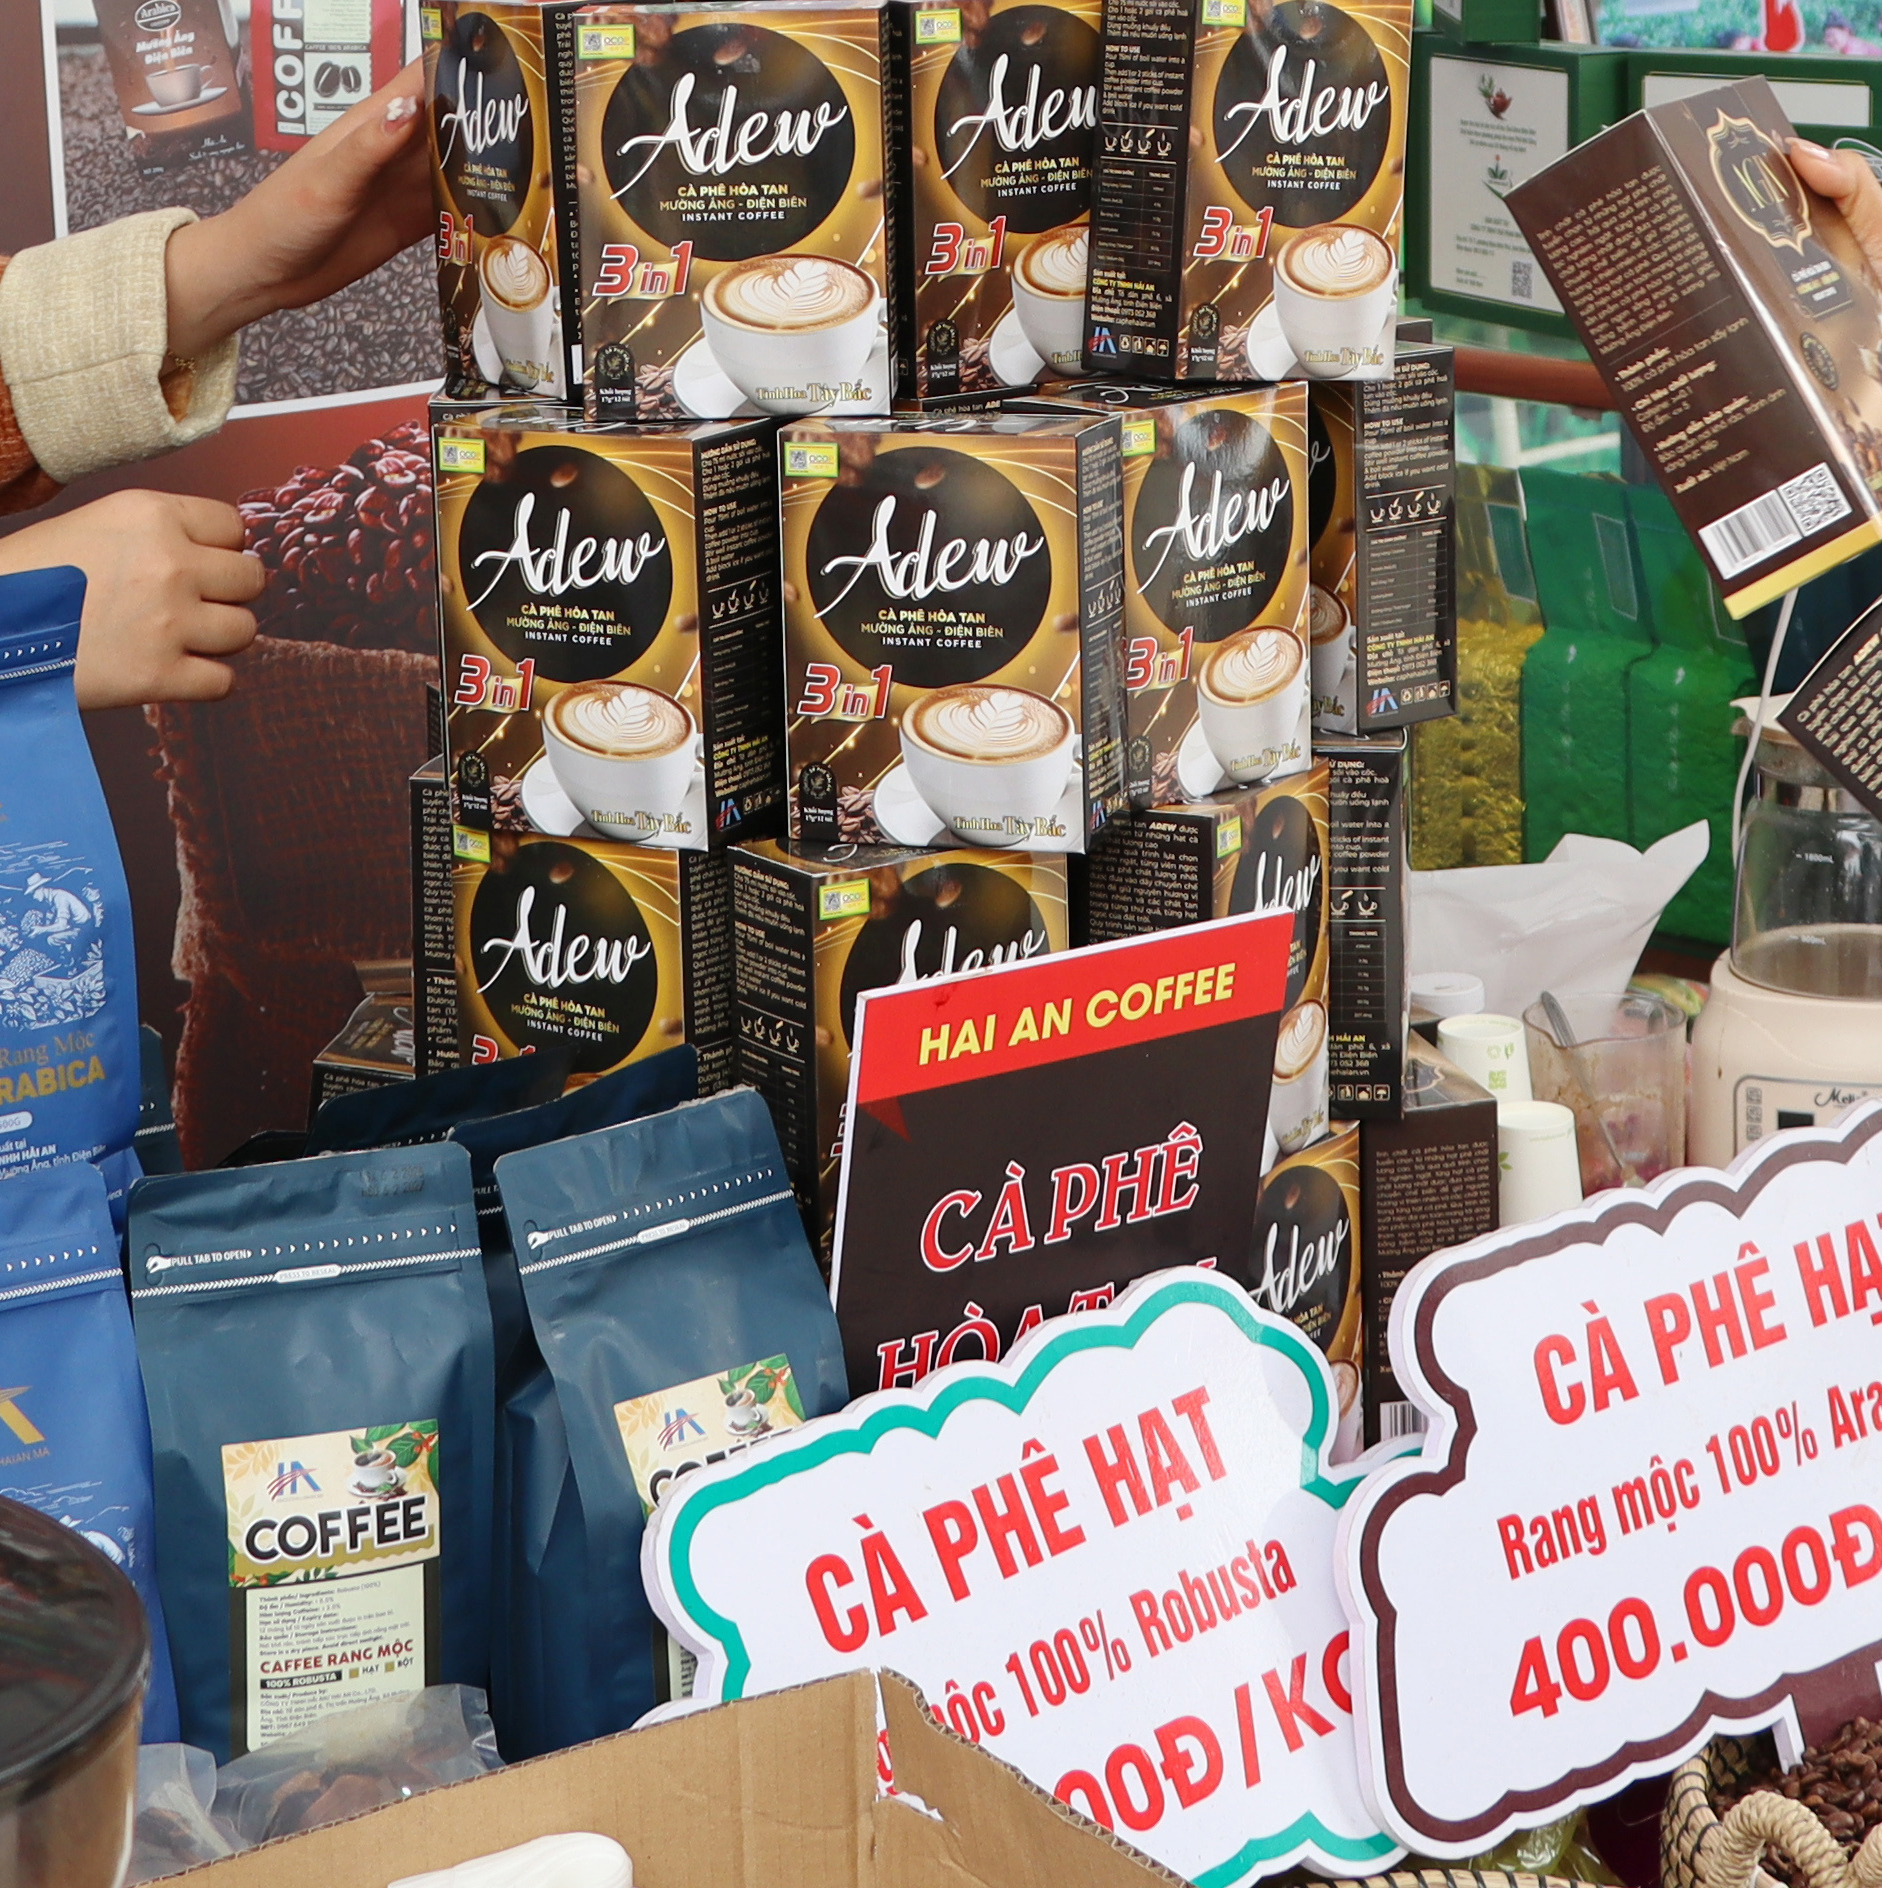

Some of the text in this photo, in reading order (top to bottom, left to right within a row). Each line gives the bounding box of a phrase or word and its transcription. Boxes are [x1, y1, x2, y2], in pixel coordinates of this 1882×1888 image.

[439, 57, 528, 170] Adew
[610, 72, 848, 200] Adew
[1215, 45, 1388, 163] Adew
[678, 184, 697, 197] CÀ
[700, 183, 726, 196] PHÊ
[761, 184, 788, 195] TAN
[682, 211, 785, 221] INSTANT COFFEE
[747, 198, 776, 210] ĐIỆN
[779, 198, 807, 208] BIÊN
[1267, 180, 1341, 190] INSTANT COFFEE
[466, 492, 667, 611] Adew
[814, 495, 1044, 619] Adew
[1138, 461, 1290, 594] Adew
[525, 631, 612, 646] INSTANT COFFEE
[477, 885, 651, 994] Adew
[919, 963, 1237, 1065] HAI AN COFFEE
[919, 1121, 1203, 1273] CÀ PHÊ
[172, 1256, 193, 1266] PULL
[194, 1255, 210, 1264] TAB
[211, 1252, 222, 1262] TO
[1533, 1300, 1640, 1425] CÀ
[1643, 1241, 1788, 1386] PHÊ
[245, 1496, 427, 1560] COFFEE
[804, 1385, 1228, 1653] CÀ PHÊ HẠT
[1496, 1503, 1606, 1581] Rang
[1613, 1454, 1701, 1533] mộc
[1705, 1401, 1819, 1496] 100%
[260, 1639, 414, 1674] CAFFEE RANG MỘC
[266, 1676, 291, 1688] 100%
[293, 1672, 337, 1686] ROBUSTA
[1004, 1609, 1132, 1717] 100%
[1129, 1539, 1298, 1659] Robusta
